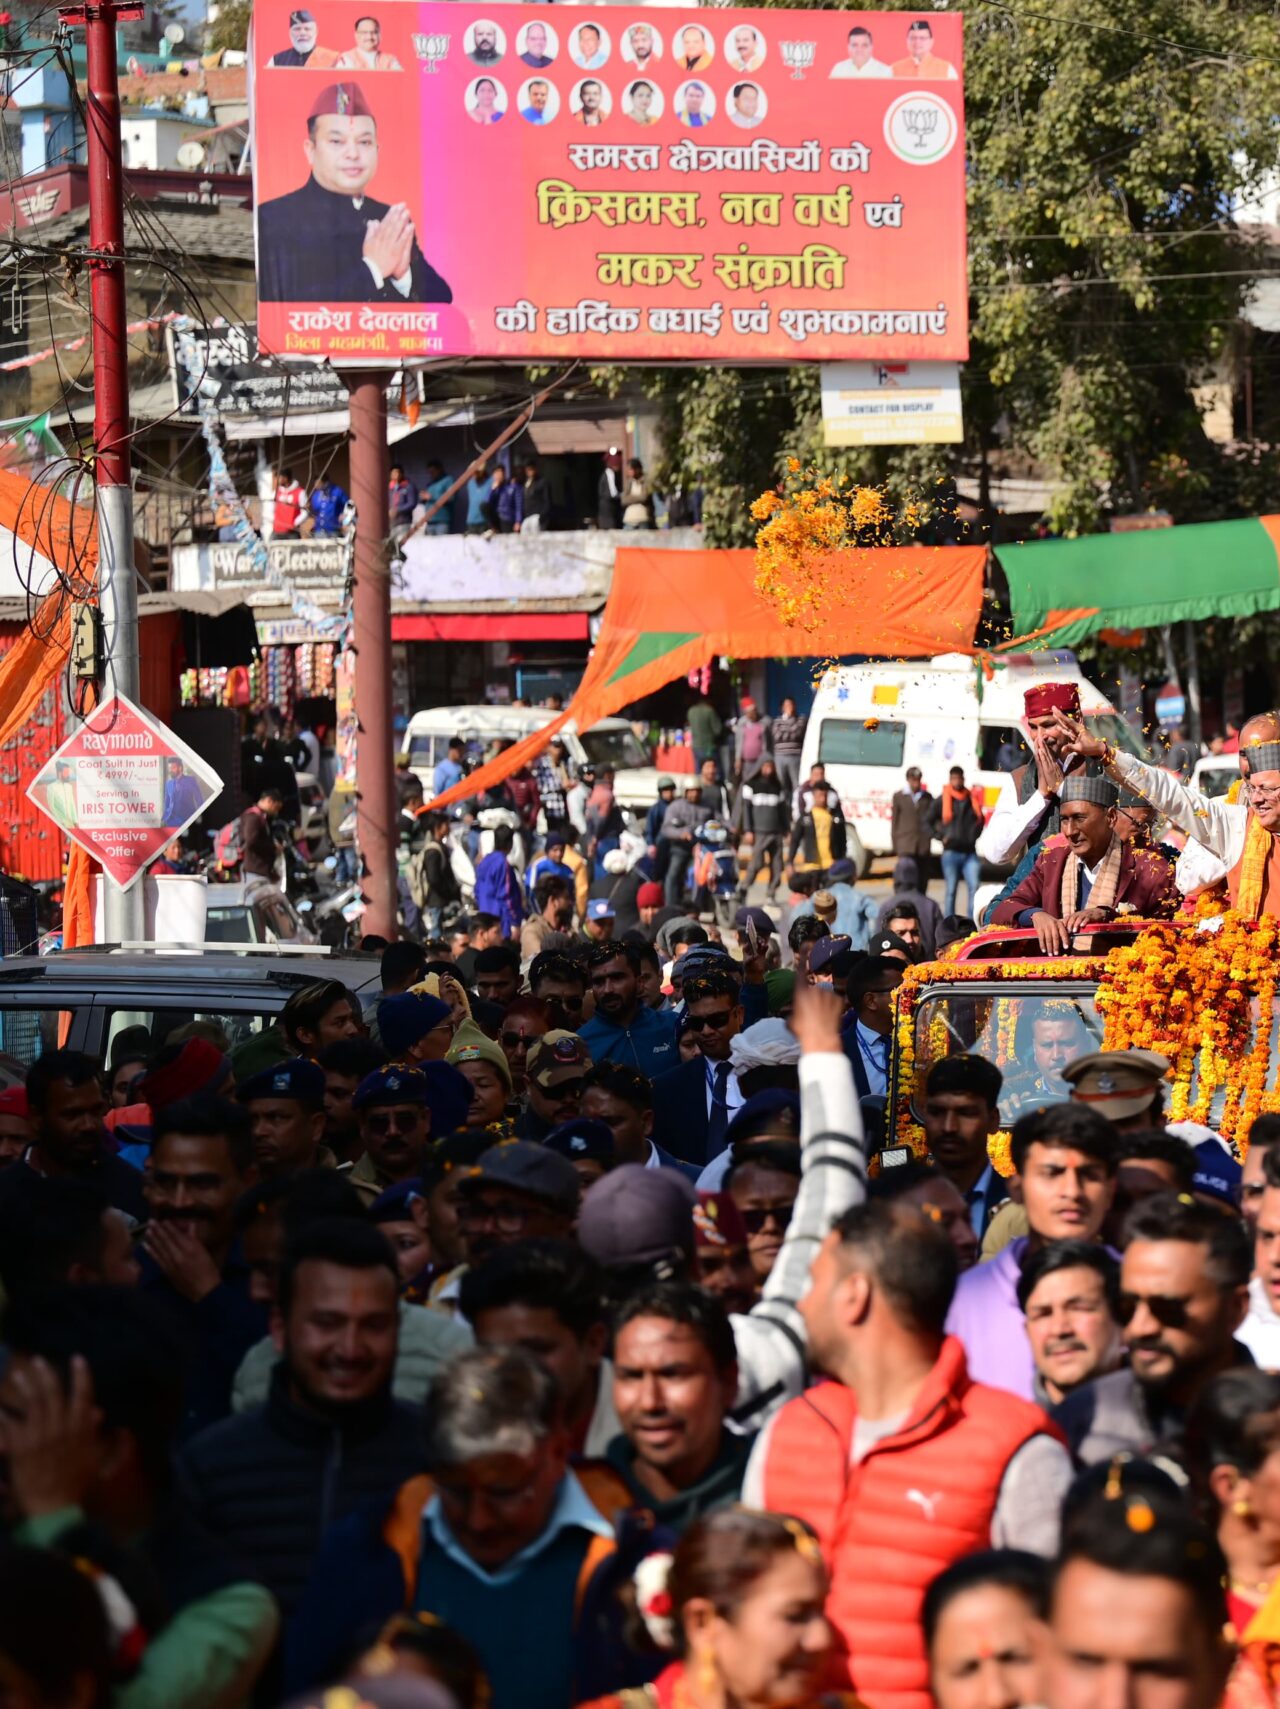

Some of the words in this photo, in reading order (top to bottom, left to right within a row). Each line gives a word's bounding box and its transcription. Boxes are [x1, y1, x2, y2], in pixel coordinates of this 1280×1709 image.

[568, 143, 661, 171] समस्त
[669, 140, 821, 173] क्षेत्रवासियों
[829, 143, 871, 173] को
[537, 179, 707, 228] क्रिसमस,
[720, 192, 784, 227] नव
[794, 185, 852, 228] वर्ष
[863, 194, 904, 228] एवं
[597, 252, 703, 288] मकर
[289, 307, 352, 331] राकेश
[358, 306, 439, 331] देवलाल
[494, 300, 537, 333] की
[545, 300, 640, 335] हार्दिक
[648, 303, 722, 338] बधाई
[730, 304, 770, 335] एवं
[778, 302, 948, 340] शुभकामनाएं
[848, 404, 884, 414] CONTACT
[886, 403, 900, 413] FOR
[902, 402, 934, 413] DISPLAY
[82, 730, 153, 755] Raymond
[79, 760, 102, 769] Coat
[105, 759, 123, 768] Suit
[126, 759, 135, 768] In
[138, 759, 157, 768] Just
[96, 790, 128, 799] Serving
[131, 790, 139, 798] In
[82, 803, 104, 814] IRIS
[108, 803, 155, 814] TOWER
[91, 831, 148, 842] Exclusive
[105, 846, 135, 857] Offer
